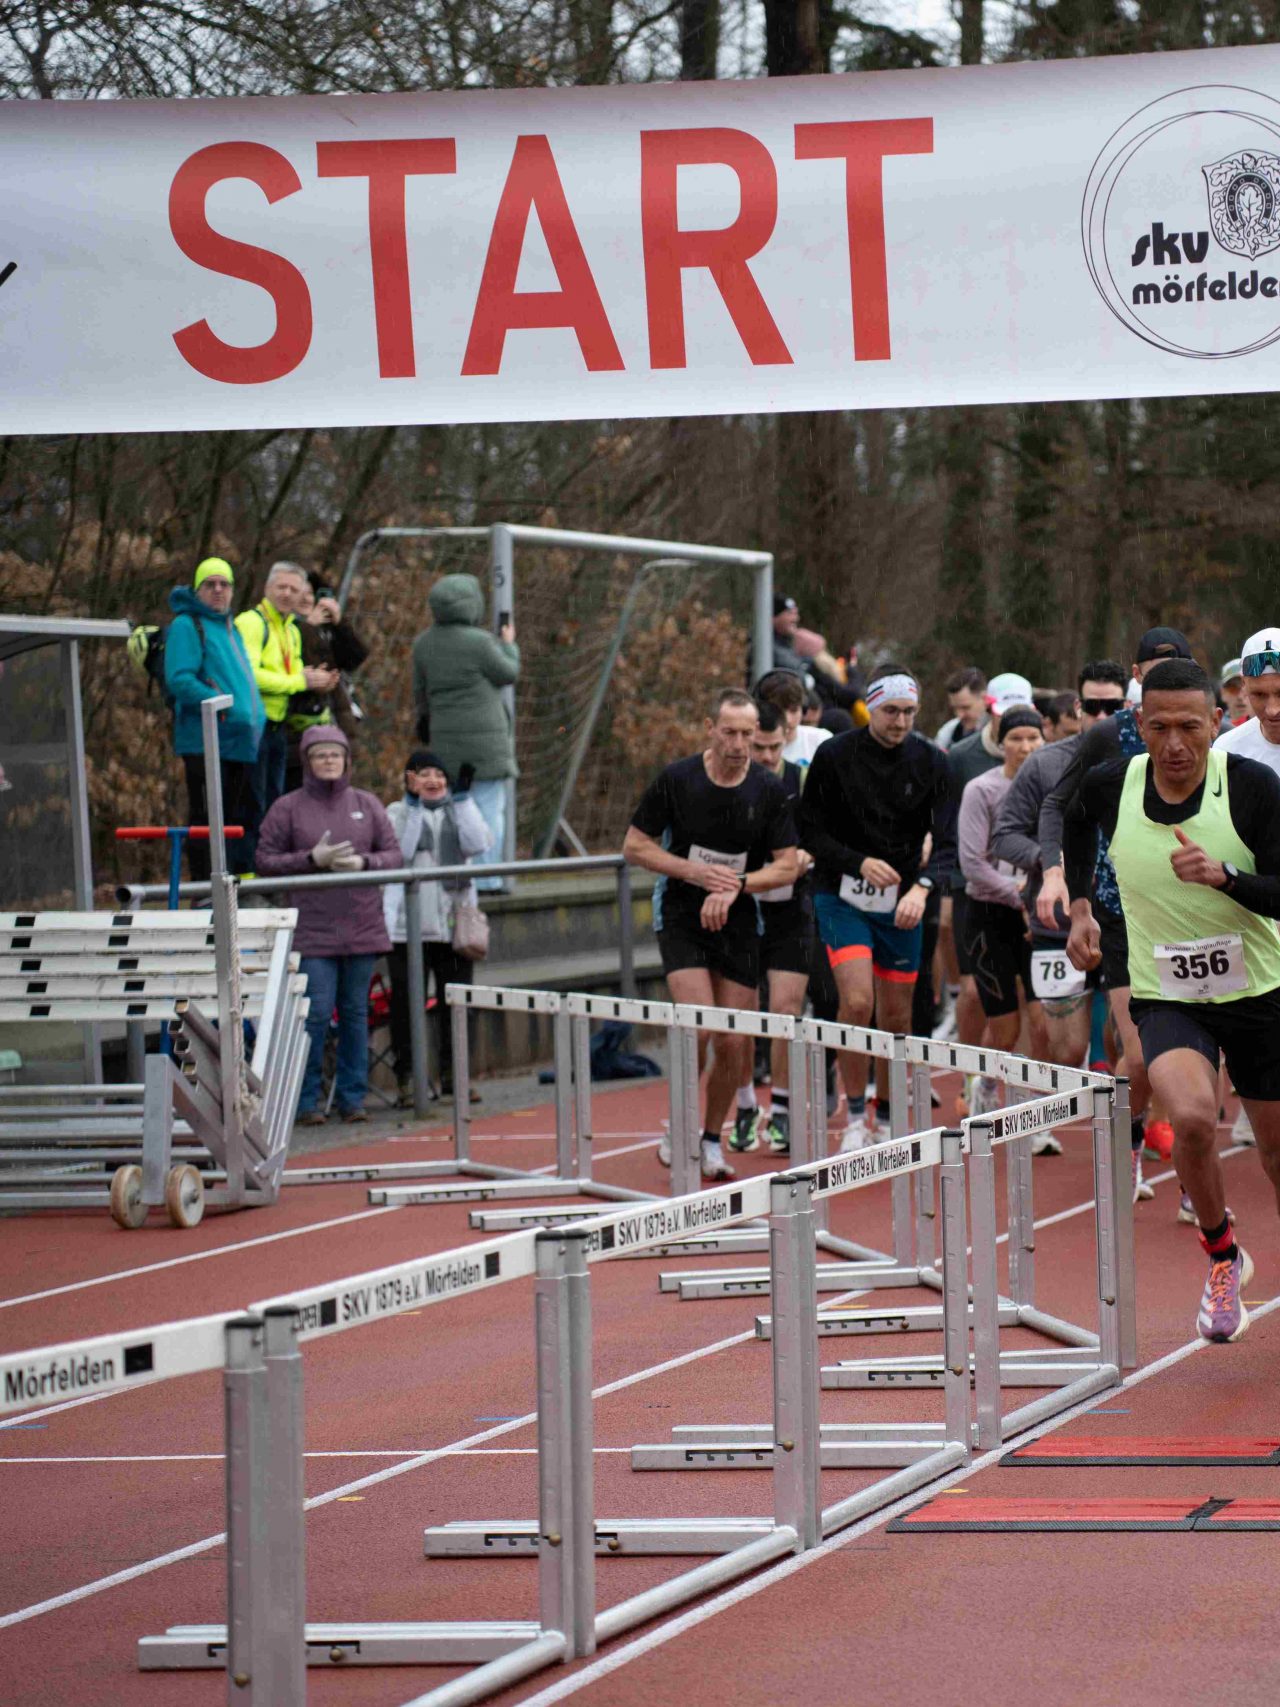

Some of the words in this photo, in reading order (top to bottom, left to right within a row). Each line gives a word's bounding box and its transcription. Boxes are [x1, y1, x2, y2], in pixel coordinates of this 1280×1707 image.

[168, 116, 933, 385] START
[1131, 222, 1209, 268] skv
[1040, 960, 1066, 981] 78
[1170, 949, 1230, 980] 356
[1004, 1114, 1019, 1136] SKV
[831, 1163, 847, 1187] SKV
[849, 1156, 865, 1180] 1879
[878, 1146, 909, 1173] Mörfelden
[618, 1218, 641, 1246] SKV
[644, 1211, 665, 1239] 1879
[667, 1208, 680, 1233] e.V.
[683, 1198, 727, 1229] Mörfelden
[342, 1288, 373, 1322] SKV
[374, 1278, 402, 1312] 1879
[404, 1273, 422, 1302] e.V.
[425, 1259, 480, 1295] Mörfelden
[4, 1355, 115, 1402] Mörfelden
